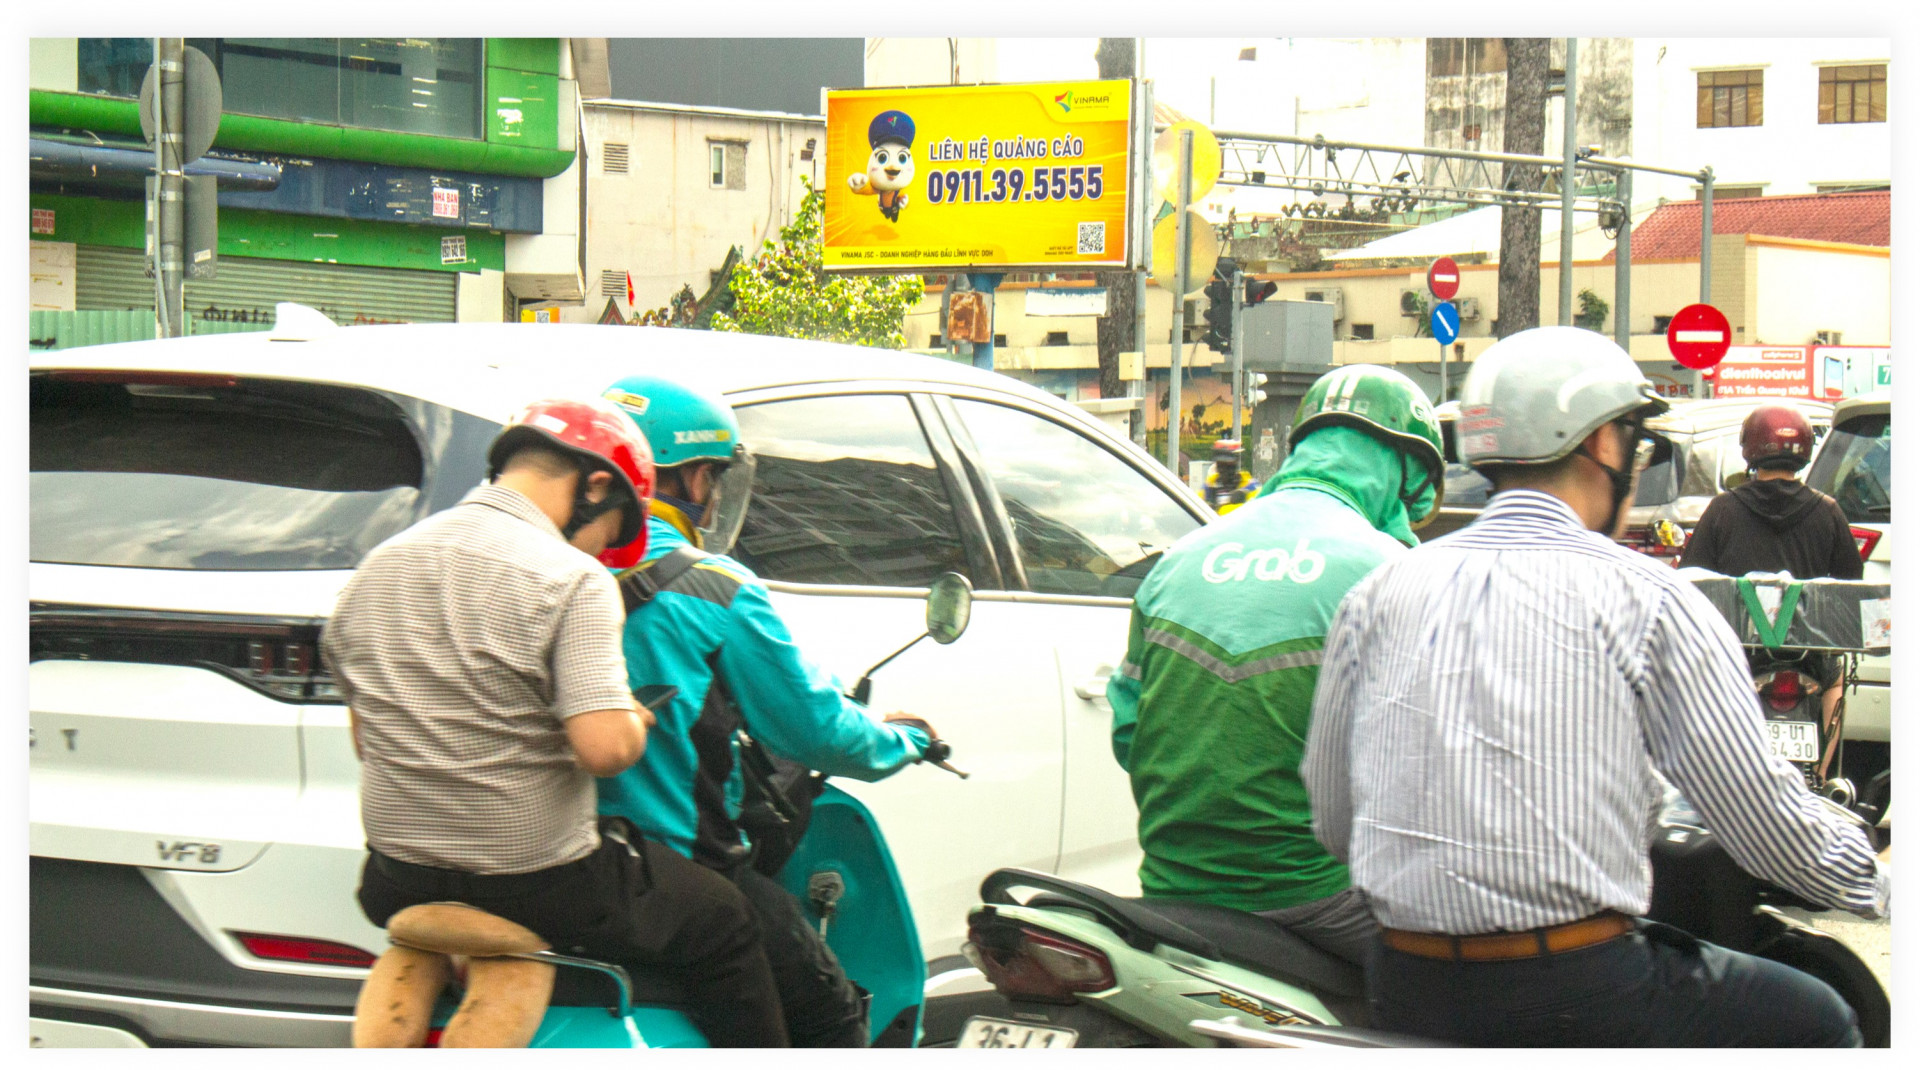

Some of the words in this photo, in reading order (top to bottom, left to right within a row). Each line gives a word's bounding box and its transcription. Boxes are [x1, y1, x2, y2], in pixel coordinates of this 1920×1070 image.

[1074, 96, 1110, 104] VINAMA
[929, 138, 963, 160] LIÊN
[969, 137, 988, 164] HỆ
[994, 136, 1047, 158] QUẢNG
[1052, 134, 1083, 156] CÁO
[928, 166, 1103, 203] 0911.39.5555
[901, 249, 922, 259] NGHIỆP
[1201, 538, 1326, 584] Grab
[156, 840, 222, 864] VF8
